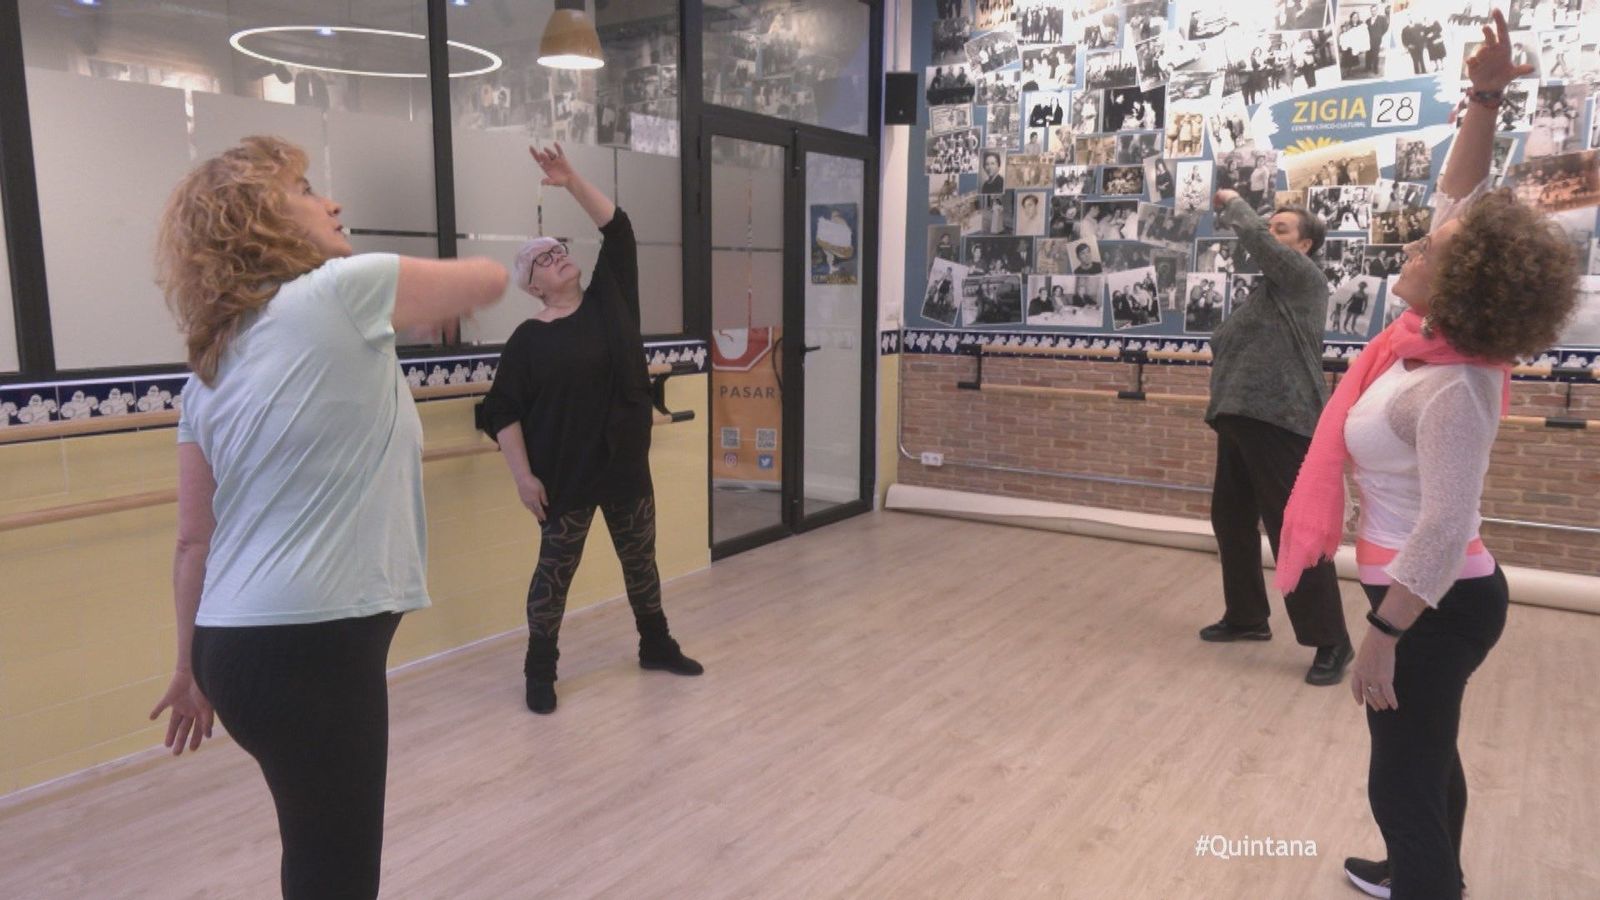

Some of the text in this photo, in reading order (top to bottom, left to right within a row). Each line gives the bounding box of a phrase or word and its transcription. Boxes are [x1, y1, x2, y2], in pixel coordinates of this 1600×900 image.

[1291, 96, 1414, 123] ZIGIA 28
[719, 385, 776, 399] PASAR
